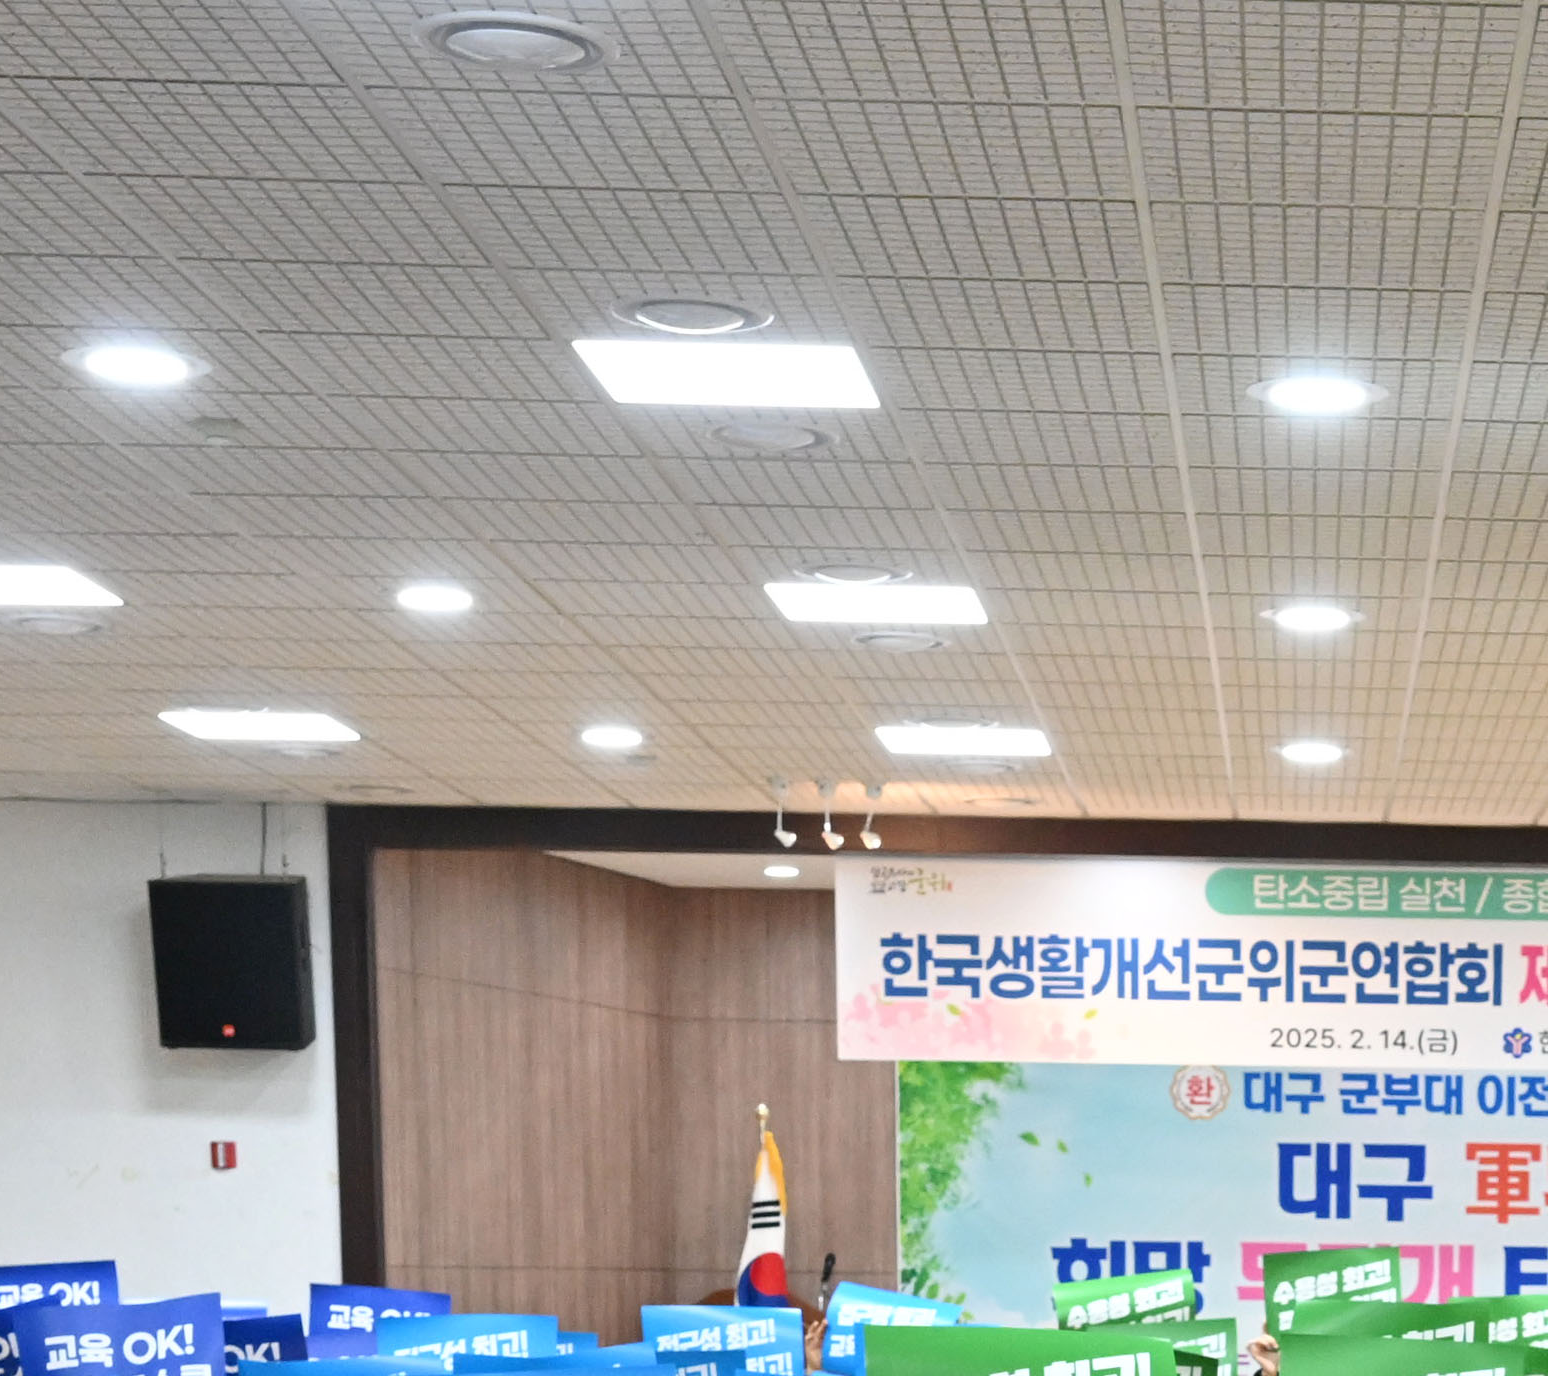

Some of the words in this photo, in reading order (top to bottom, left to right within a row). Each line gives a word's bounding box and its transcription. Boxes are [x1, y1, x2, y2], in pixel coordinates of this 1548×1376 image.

[1253, 873, 1389, 913] 탄소중립
[1399, 876, 1466, 913] 실천
[879, 932, 1503, 1006] 한국생활개선군위군연합회
[1269, 1027, 1342, 1049] 2025.
[1350, 1029, 1372, 1050] 2.
[1379, 1029, 1459, 1055] 14.(금)
[1185, 1074, 1215, 1106] 환
[1243, 1071, 1325, 1115] 대구
[1339, 1073, 1464, 1116] 군부대
[1276, 1141, 1434, 1222] 대구
[44, 1333, 115, 1372] 교육
[122, 1322, 195, 1366] OK!
